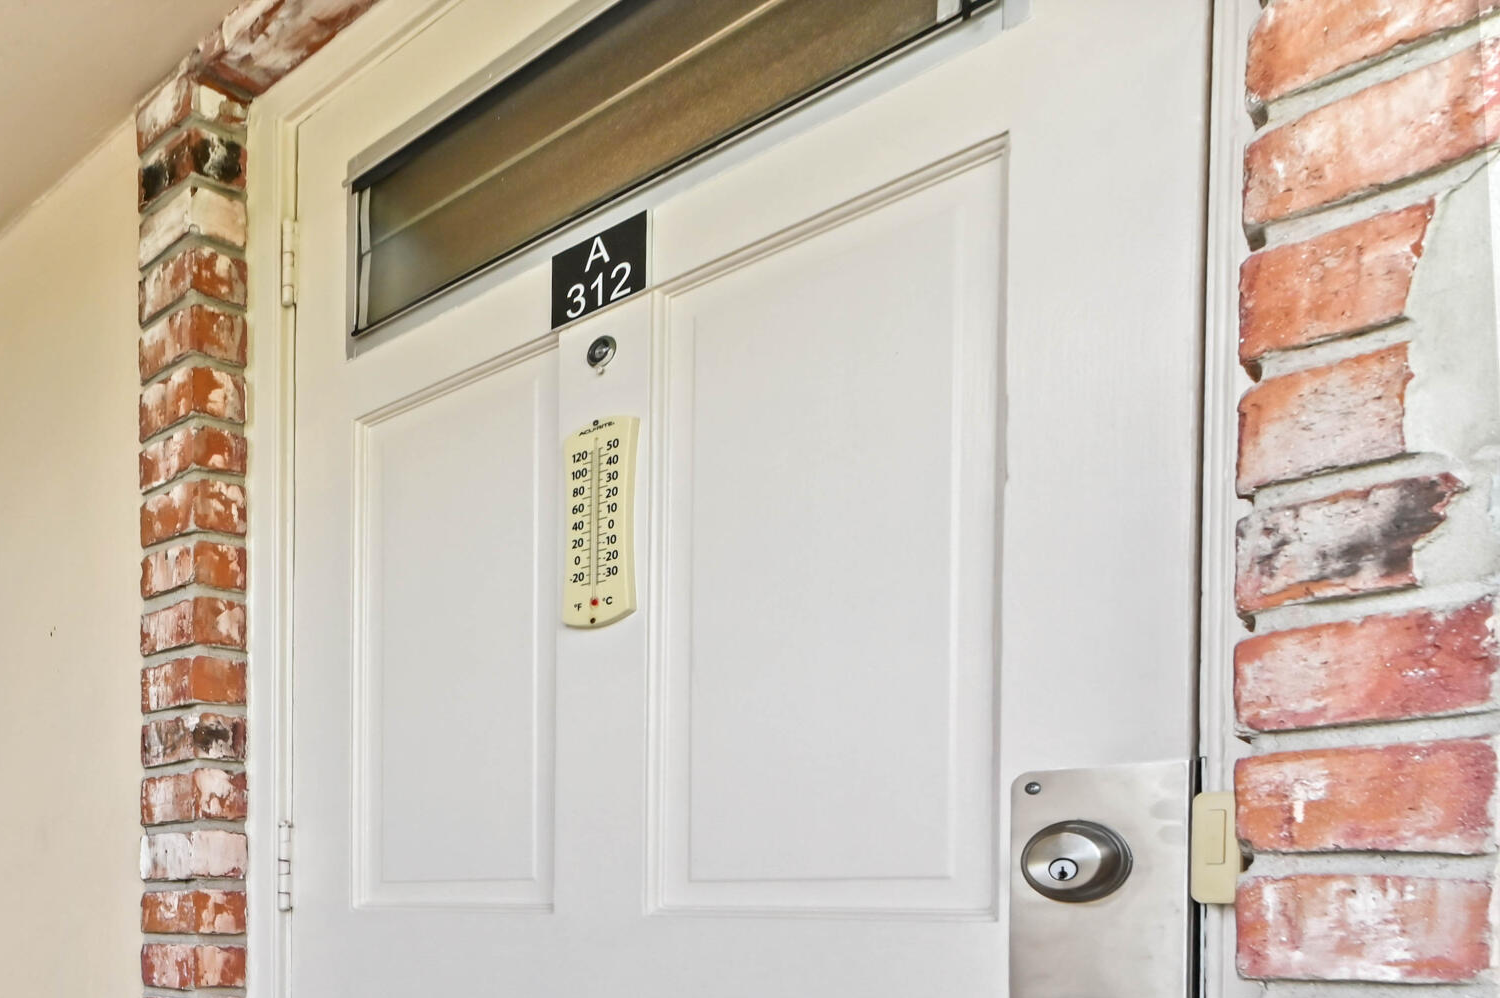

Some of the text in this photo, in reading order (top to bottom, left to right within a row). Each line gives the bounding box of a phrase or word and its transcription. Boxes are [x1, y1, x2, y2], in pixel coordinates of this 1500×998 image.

[585, 235, 611, 273] A
[566, 261, 632, 319] 312
[606, 438, 619, 451] 50
[572, 450, 588, 463] 120
[606, 454, 619, 466] 40
[572, 467, 588, 481] 100
[605, 470, 619, 483] 30
[572, 485, 585, 498] 80
[605, 486, 618, 498] 20
[571, 503, 585, 515] 60
[606, 502, 617, 513] 10
[571, 520, 584, 531] 40
[607, 519, 615, 529] 0
[571, 537, 584, 549] 20
[574, 555, 581, 565] 0
